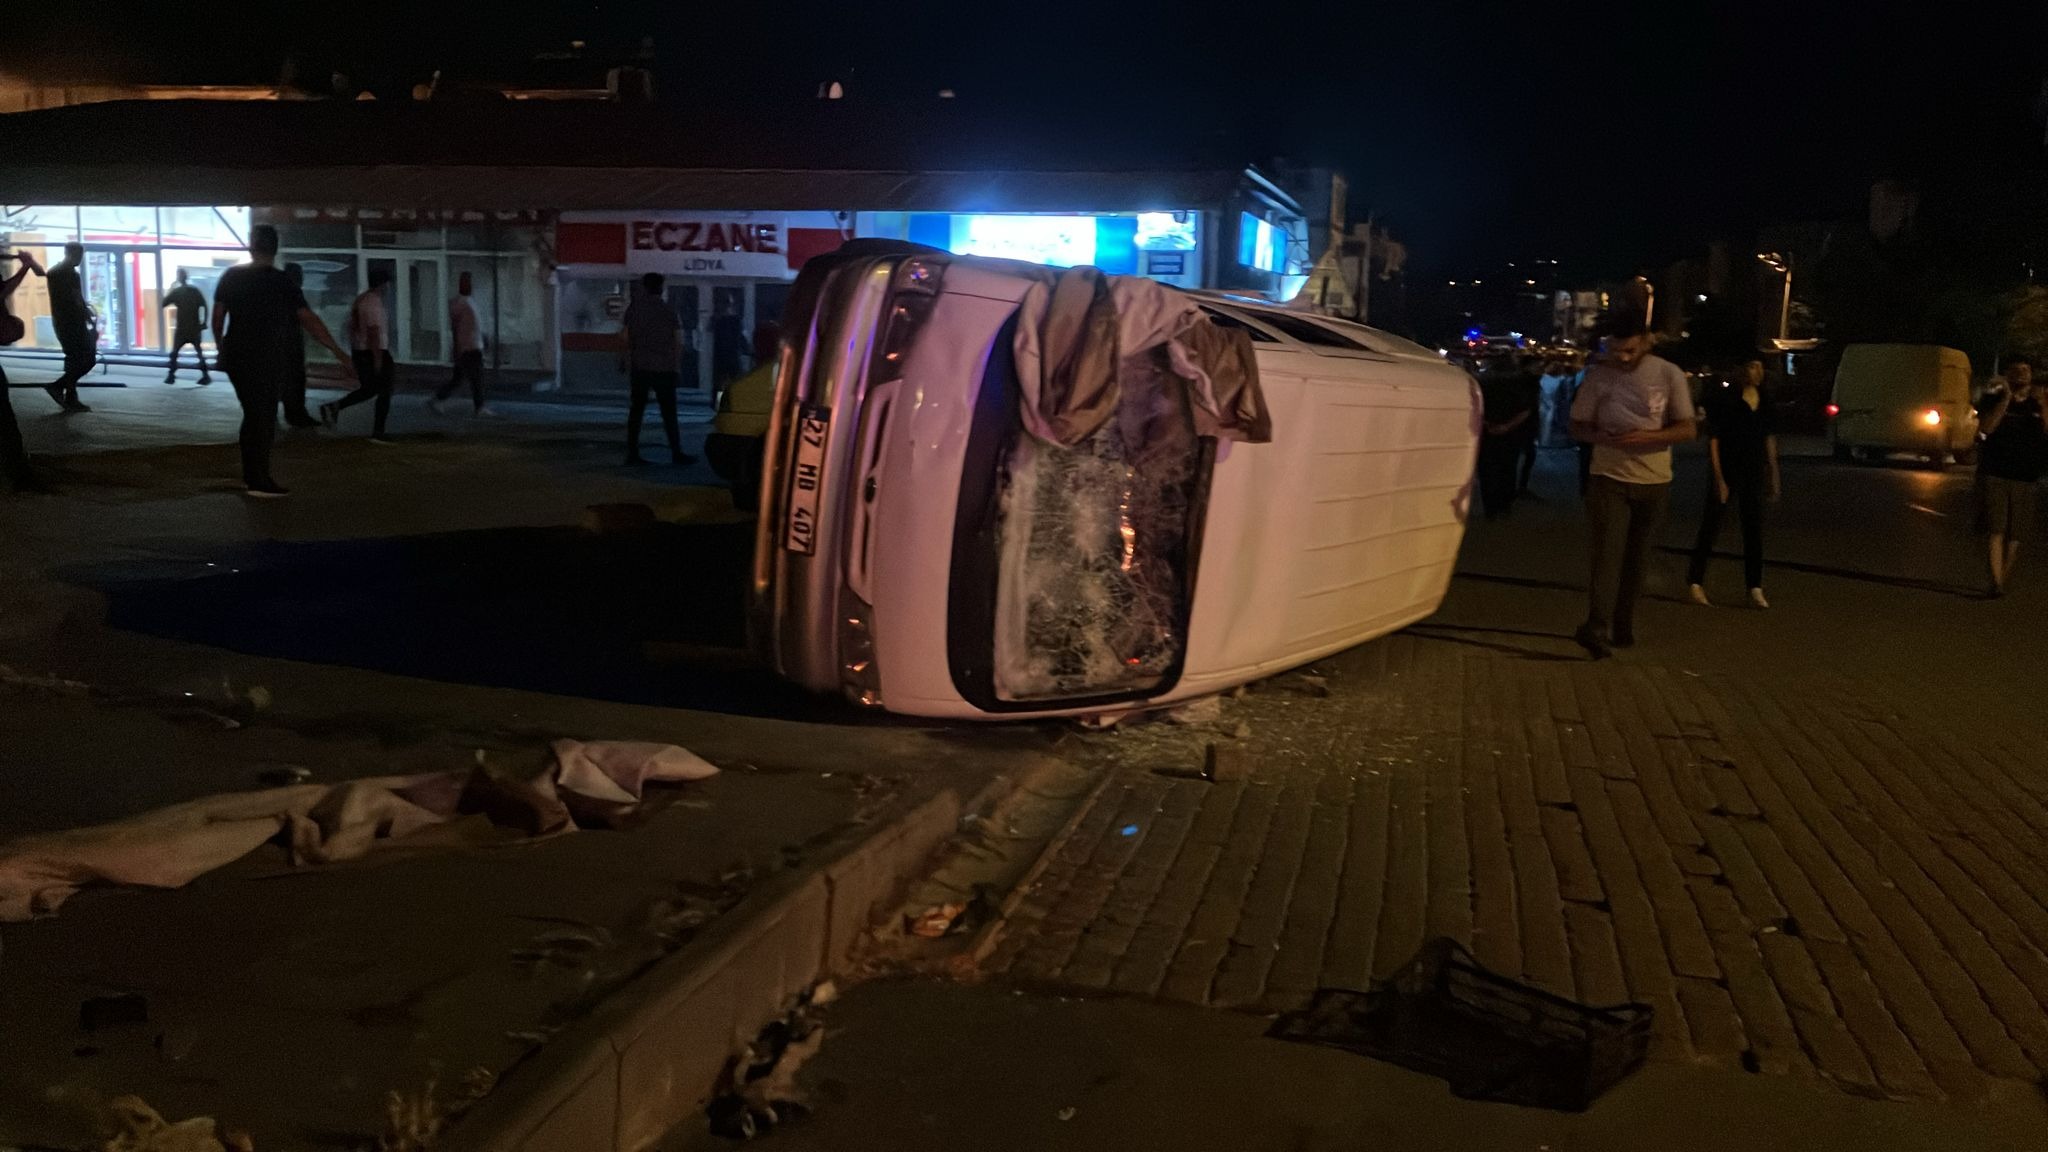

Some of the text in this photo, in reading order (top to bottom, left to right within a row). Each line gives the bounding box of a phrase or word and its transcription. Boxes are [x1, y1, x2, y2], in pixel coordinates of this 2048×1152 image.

[633, 222, 778, 253] ECZANE
[804, 420, 822, 447] 27
[793, 507, 812, 550] 407
